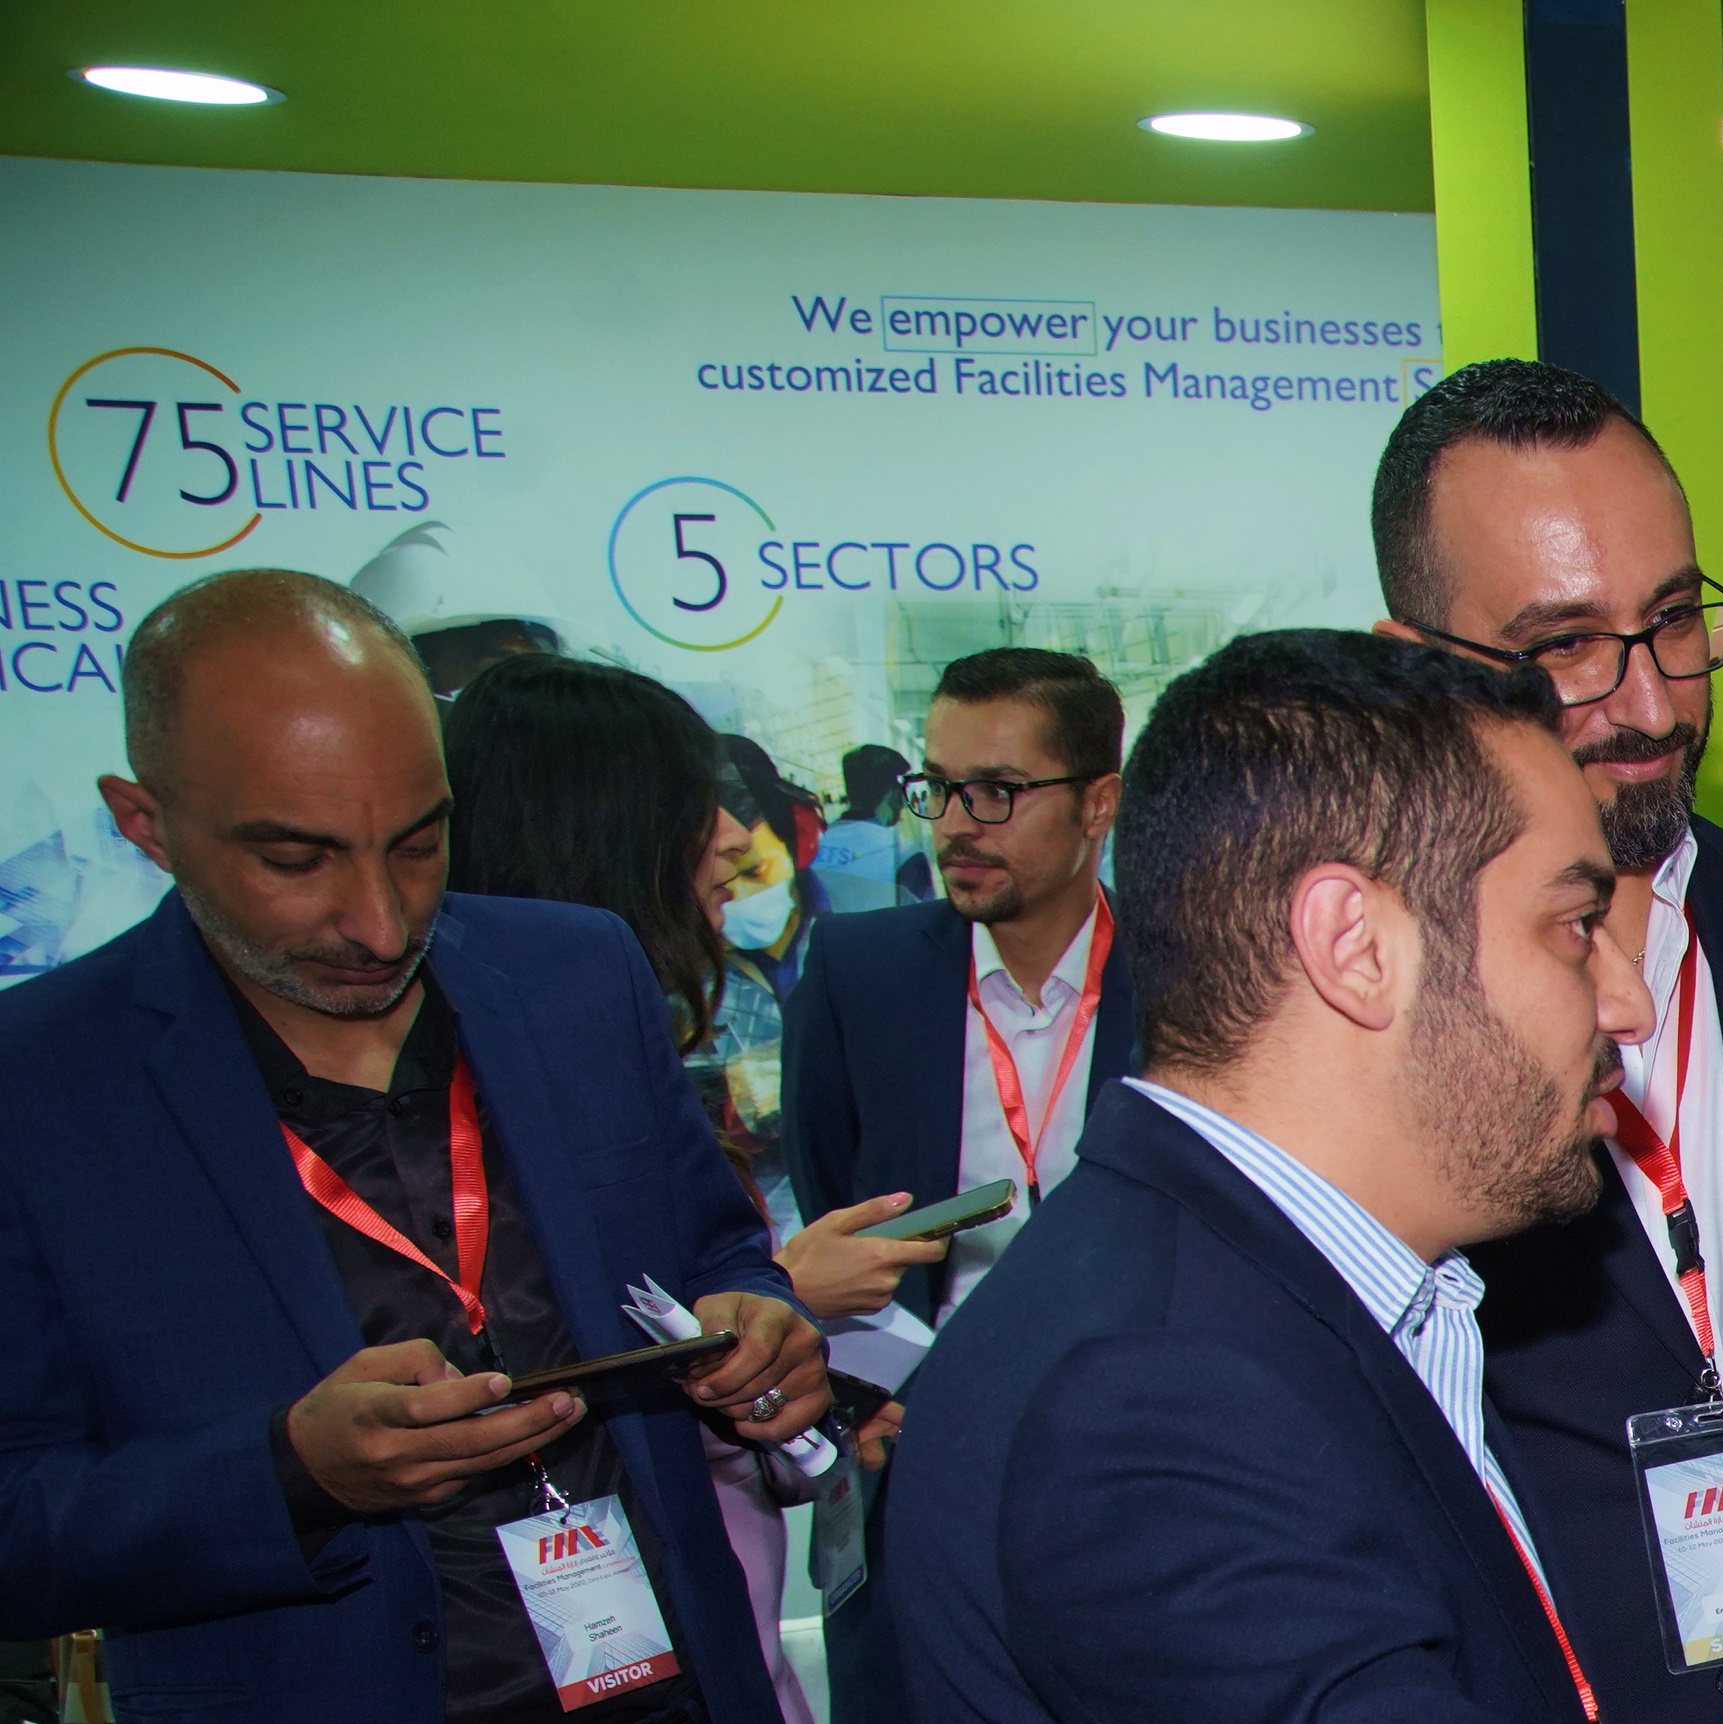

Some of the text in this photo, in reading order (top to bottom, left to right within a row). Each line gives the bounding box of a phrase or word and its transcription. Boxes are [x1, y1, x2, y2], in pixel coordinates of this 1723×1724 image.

[791, 295, 872, 335] We
[889, 308, 1088, 348] empower
[1102, 314, 1198, 351] your
[1214, 306, 1422, 347] businesses
[697, 357, 937, 394] customized
[955, 358, 1127, 397] Facilities
[1144, 362, 1399, 411] Management
[85, 398, 240, 506] 75
[240, 402, 506, 458] SERVICE
[250, 459, 430, 512] LINES
[672, 512, 729, 612] 5
[758, 540, 1040, 593] SECTORS
[0, 580, 123, 632] ESS
[1664, 1533, 1700, 1546] Facilities
[556, 1564, 602, 1581] Management
[583, 1615, 617, 1632] Hamzeh
[588, 1624, 623, 1643] Shaheen
[587, 1661, 654, 1695] VISITOR
